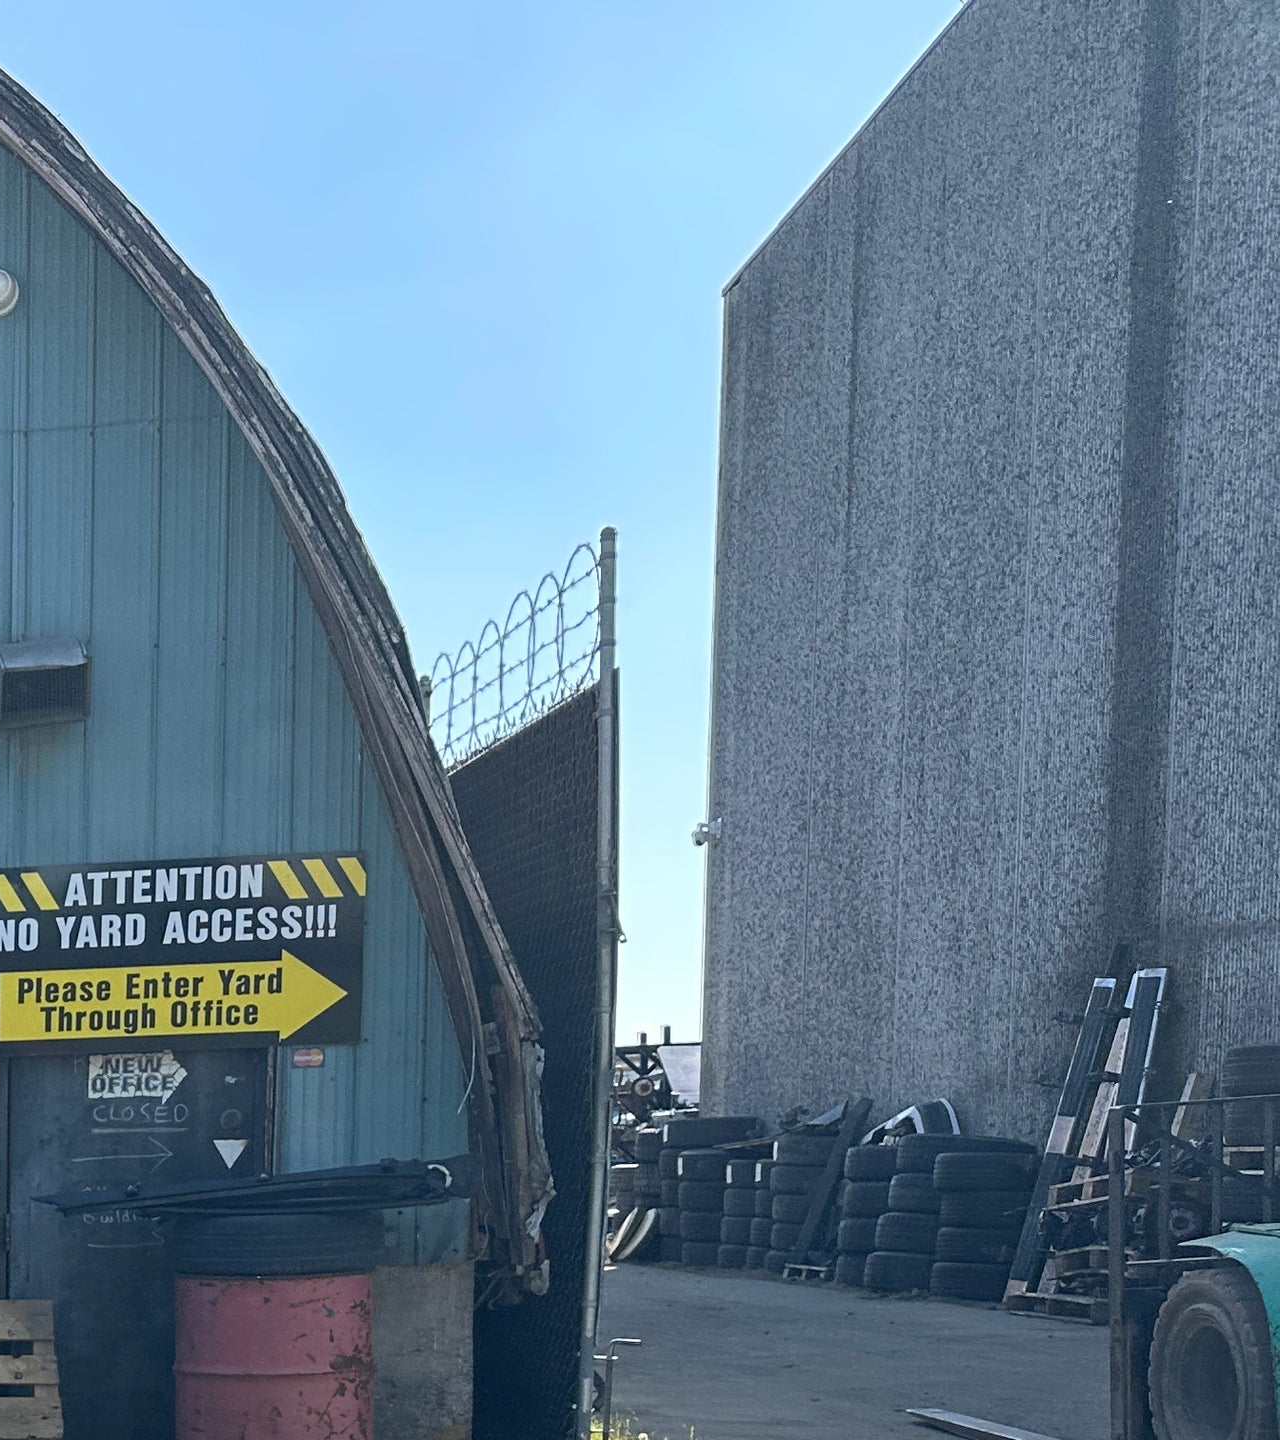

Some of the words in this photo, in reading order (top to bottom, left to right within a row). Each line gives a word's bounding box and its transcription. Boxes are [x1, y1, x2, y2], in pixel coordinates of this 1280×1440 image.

[64, 864, 264, 907] ATTENTION
[55, 913, 146, 949] YARD
[162, 904, 337, 945] ACCESS!!!
[18, 976, 111, 1004] Please
[126, 973, 203, 1000] Enter
[218, 967, 283, 995] Yard
[41, 1005, 156, 1034] Through
[171, 1000, 258, 1028] Office
[104, 1055, 162, 1073] NEW
[91, 1074, 176, 1093] OFFICE
[93, 1102, 189, 1123] CLOSED
